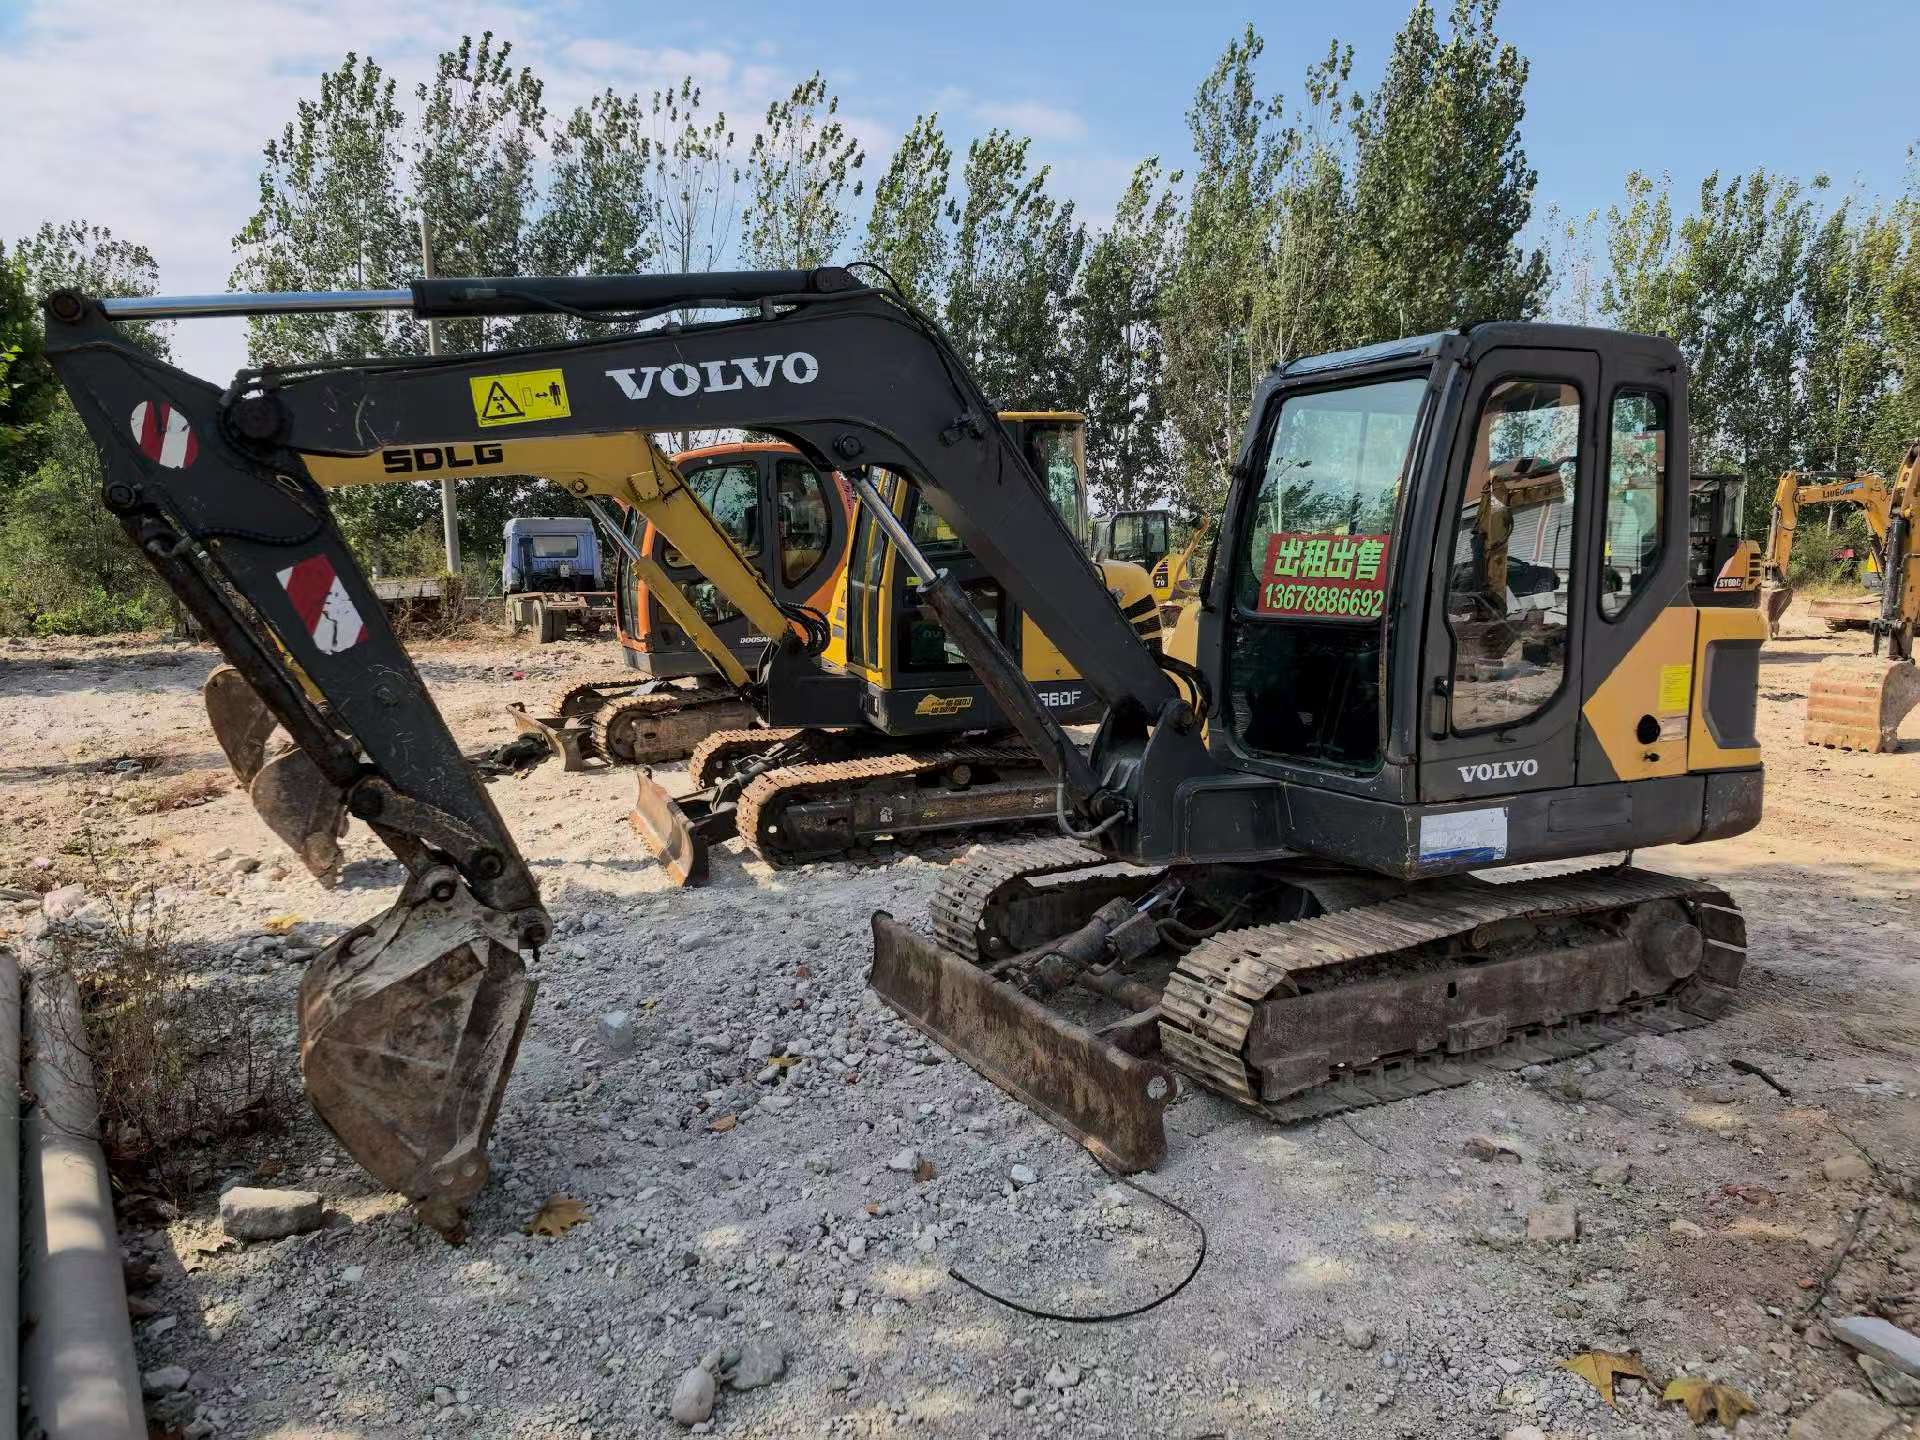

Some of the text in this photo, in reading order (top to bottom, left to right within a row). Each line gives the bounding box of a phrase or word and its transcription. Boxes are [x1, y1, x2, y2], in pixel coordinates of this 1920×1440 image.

[606, 352, 819, 400] VOLVO
[383, 443, 504, 473] SDLG
[1274, 538, 1385, 581] 出租出售
[1265, 583, 1385, 617] 13678886692
[1458, 758, 1538, 783] VOLVO
